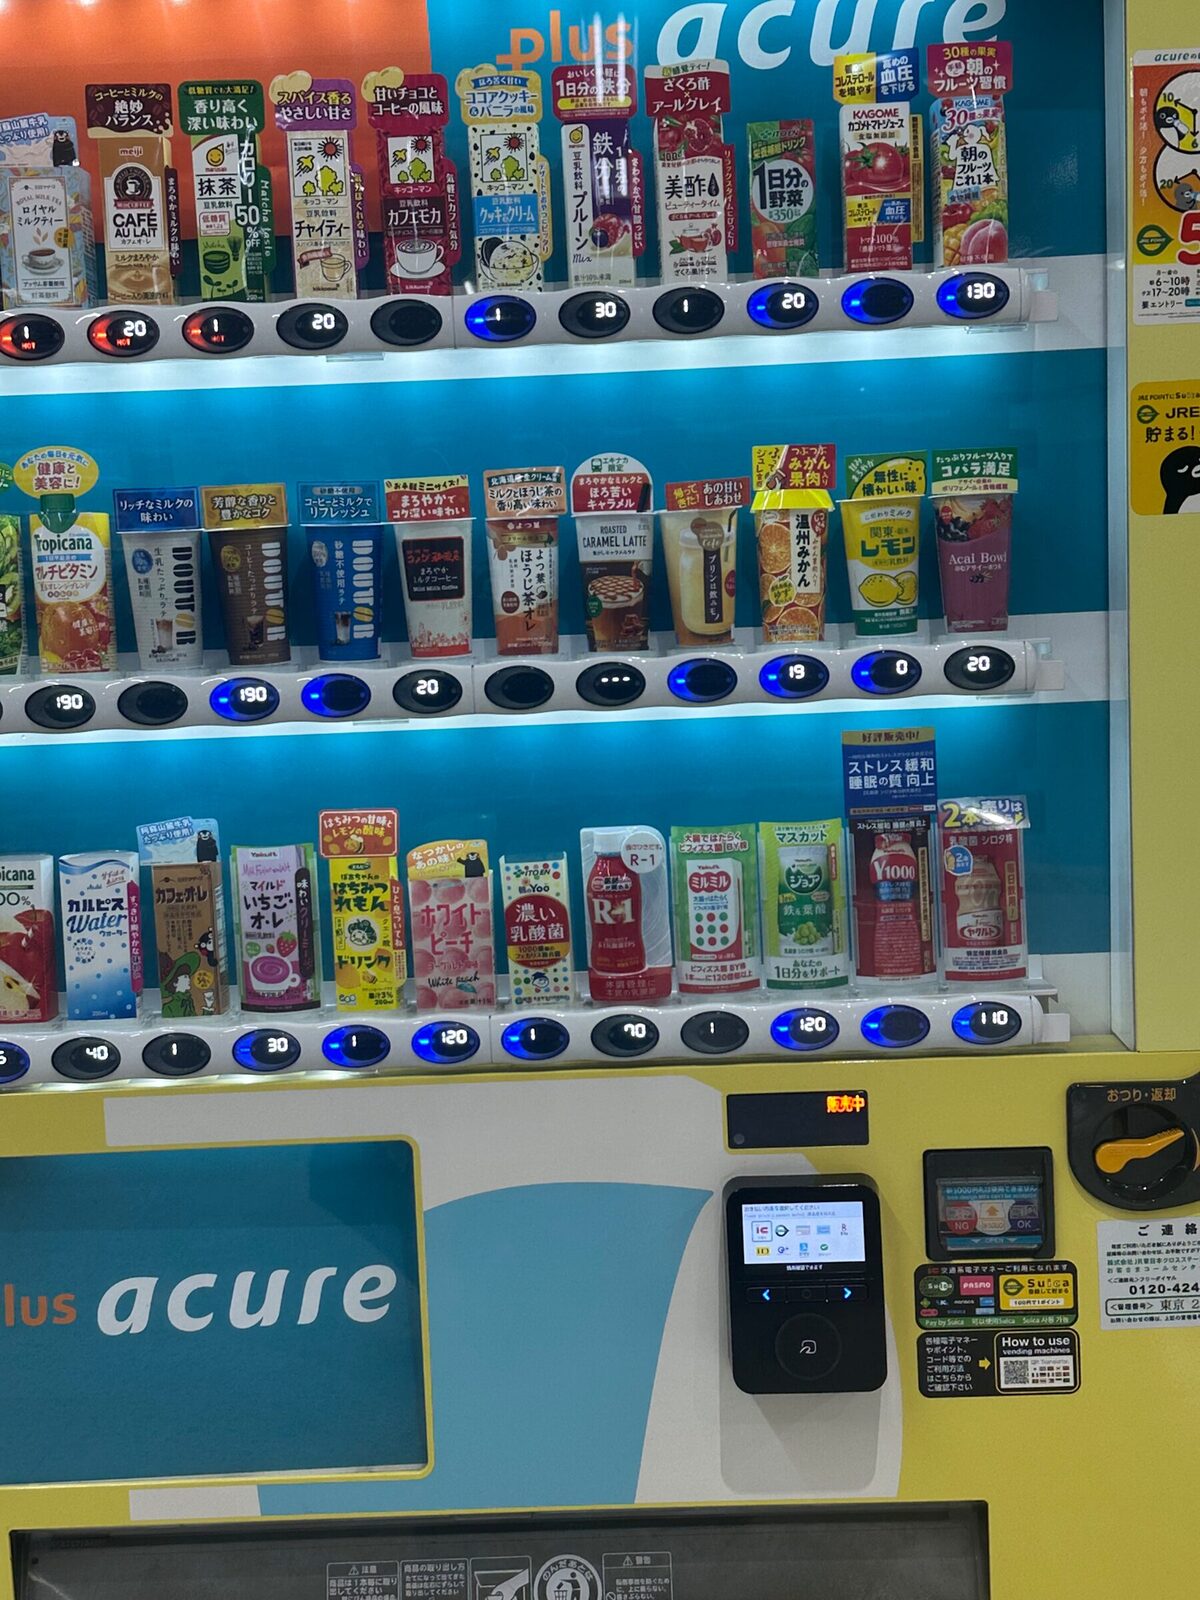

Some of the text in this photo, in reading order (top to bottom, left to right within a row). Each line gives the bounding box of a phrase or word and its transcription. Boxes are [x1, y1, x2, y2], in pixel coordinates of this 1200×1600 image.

[496, 0, 1006, 72] plus acure
[942, 46, 997, 60] 30種の果実
[882, 56, 909, 69] 高めの
[965, 58, 993, 76] 朝の
[835, 75, 875, 87] コレステロール
[880, 65, 914, 84] 血圧
[664, 77, 711, 92] ざくろ酢
[933, 75, 1007, 93] フルーツ習慣
[94, 87, 163, 102] コーヒーとミルクの
[277, 91, 352, 106] スパイス香る
[374, 86, 438, 101] 甘いチョコと
[465, 91, 538, 105] ココアクッキー
[1163, 92, 1174, 102] 10
[114, 100, 143, 114] 絶妙
[194, 99, 248, 113] 香り高く
[281, 105, 352, 121] やさしい甘さ
[373, 101, 445, 116] コーヒーの風味
[652, 98, 722, 114] アールグレイ
[853, 108, 899, 118] KAGOME
[105, 113, 154, 127] バランス
[187, 116, 258, 131] 深い味わい
[847, 119, 904, 132] カゴメトマトジュース
[1192, 139, 1199, 148] 6
[119, 146, 144, 158] meiji
[961, 147, 988, 162] 朝の
[571, 151, 584, 191] 豆乳飲料
[957, 161, 993, 174] フルーツ
[198, 177, 238, 197] 抹茶
[956, 173, 995, 187] これ1本
[1160, 178, 1174, 189] 20
[393, 184, 433, 194] キッコーマン
[202, 200, 234, 209] 豆乳飲料
[303, 197, 339, 206] キッコーマン
[769, 189, 804, 209] 野菜
[22, 205, 57, 215] ロイヤル
[112, 208, 158, 227] CAFÉ
[306, 209, 337, 218] 豆乳飲料
[387, 208, 442, 226] カフェモカ
[16, 215, 64, 227] ミルクティー
[572, 193, 589, 251] プルーン
[114, 227, 158, 238] AU LAIT
[294, 220, 350, 239] チャイティー
[966, 282, 996, 300] 130
[782, 292, 806, 310] 20
[594, 300, 617, 318] 30
[123, 319, 147, 337] 20
[312, 313, 335, 330] 20
[1165, 406, 1200, 419] JRE
[1145, 425, 1196, 443] 貯まる!
[603, 457, 629, 465] エキナカ
[788, 456, 831, 470] みかん
[936, 453, 1014, 464] たっぷりフルーツ入りで
[37, 461, 76, 476] 健康と
[607, 463, 625, 472] 限定
[941, 462, 1012, 477] コバラ満足
[34, 475, 81, 491] 美容に!
[578, 475, 643, 485] まろやかなミルクと
[873, 469, 909, 483] 無性に
[393, 478, 460, 491] お手軽ミニサイズ!
[589, 486, 632, 498] ほろ苦い
[702, 481, 743, 496] あの甘い
[861, 480, 917, 497] 懐かしい味
[400, 493, 456, 507] まろやかで
[489, 485, 563, 500] ミルクとほうじ茶の
[704, 493, 742, 506] しあわせ
[119, 498, 194, 511] リッチなミルクの
[212, 495, 277, 509] 芳醇な香りと
[304, 496, 373, 508] コーヒーとミルクで
[496, 498, 558, 512] 香り高い味わい
[587, 497, 636, 511] キャラメル
[140, 512, 174, 524] 味わい
[220, 508, 271, 521] 豊かなコク
[309, 507, 371, 519] リフレッシュ
[391, 506, 466, 520] コク深い味わい
[599, 524, 628, 535] ROASTED
[34, 533, 93, 554] Tropicana
[582, 534, 648, 549] CARAMEL LATTE
[860, 536, 917, 558] レモン
[795, 514, 811, 588] 温州みかん
[948, 551, 1008, 566] Acai Bowl
[35, 563, 98, 581] マルチビタミン
[172, 546, 197, 645] DOUTOR
[261, 541, 286, 642] DOUTOR
[352, 539, 375, 639] DOUTOR
[520, 550, 537, 632] ほうじ茶オレ
[967, 655, 990, 672] 20
[240, 686, 268, 703] 190
[416, 679, 439, 696] 20
[56, 694, 83, 711] 190
[861, 731, 920, 744] 好評販売中!
[848, 757, 934, 775] ストレス 緩和
[848, 772, 935, 790] 睡眠の質 向上
[324, 814, 393, 829] はちみつの甘味と
[332, 825, 386, 838] レモンの酸味
[776, 830, 828, 844] マスカット
[412, 842, 465, 860] なつかしの
[629, 853, 656, 867] R-1
[873, 861, 916, 881] Y1000
[249, 880, 286, 891] マイルド
[333, 881, 389, 895] はちみつ
[690, 873, 730, 890] ミルミル
[790, 873, 822, 889] ジョア
[67, 897, 125, 913] カルピス
[334, 895, 389, 913] れもん
[592, 897, 635, 925] R-1
[420, 903, 482, 925] ホワイト
[515, 902, 556, 922] 濃い
[66, 913, 128, 934] Water
[510, 923, 564, 943] 乳酸菌
[430, 931, 474, 955] ピーチ
[336, 955, 391, 970] ドリンク
[775, 965, 841, 980] 1日分をサポート
[441, 1029, 467, 1045] 120
[267, 1037, 288, 1053] 30
[86, 1045, 109, 1061] 40
[1107, 1087, 1177, 1103] おつり・返却
[955, 1221, 969, 1230] NG
[1017, 1219, 1032, 1229] OK
[1138, 1222, 1198, 1237] ご連絡
[962, 1282, 992, 1290] PASMO
[1027, 1278, 1070, 1288] Suica
[1129, 1282, 1200, 1295] 0120-424
[1028, 1287, 1070, 1295] 登録して貯まる
[4, 1263, 398, 1336] lus acure
[938, 1319, 947, 1327] by
[925, 1337, 979, 1346] 各種電子マネー
[1002, 1336, 1071, 1348] How to use
[1002, 1346, 1071, 1356] vending machines
[926, 1355, 972, 1364] コード等での
[926, 1365, 965, 1374] ご利用方法
[926, 1374, 973, 1382] はこちらから
[927, 1383, 973, 1392] ご確認下さい
[404, 1562, 466, 1573] 商品の取り出し方
[543, 1560, 594, 1581] のんだあとは
